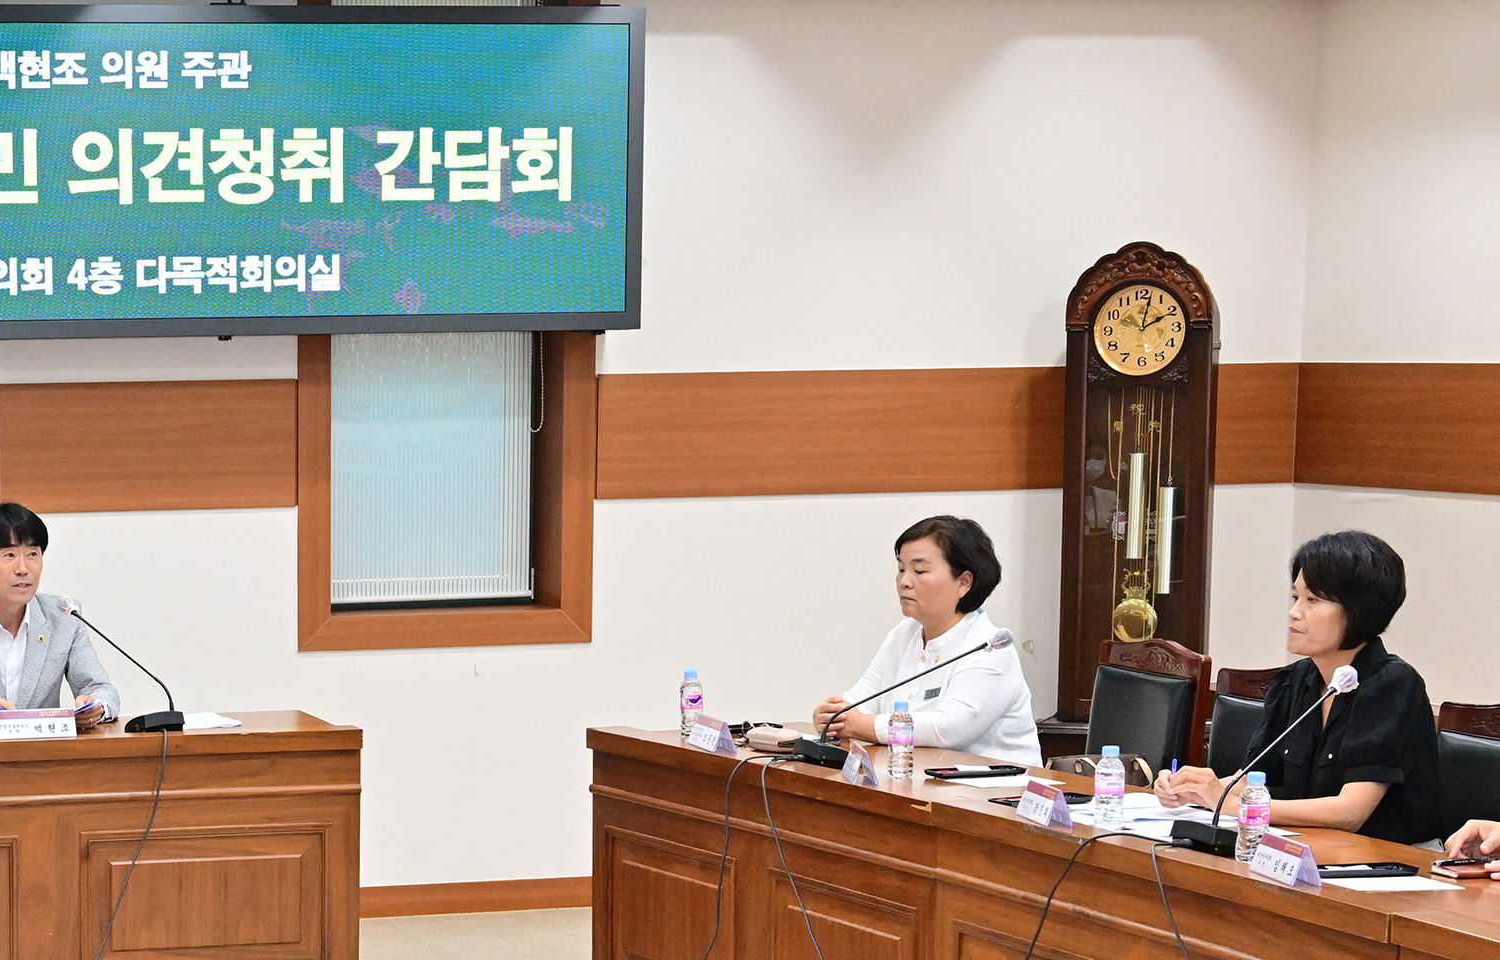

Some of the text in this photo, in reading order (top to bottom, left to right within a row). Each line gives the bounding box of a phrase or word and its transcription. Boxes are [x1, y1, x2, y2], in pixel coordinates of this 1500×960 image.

[100, 50, 169, 89] 의원
[181, 50, 252, 89] 주관
[67, 127, 344, 205] 의견청취
[373, 125, 574, 202] 간담회
[67, 256, 124, 295] 4층
[136, 253, 341, 294] 다목적회의실
[1134, 289, 1150, 301] 12
[1158, 294, 1164, 305] 1
[1119, 296, 1131, 307] 11
[1107, 309, 1120, 321] 10
[1167, 305, 1178, 317] 2
[1103, 326, 1114, 336] 9
[1171, 321, 1182, 333] 3
[1107, 340, 1119, 351] 8
[1165, 337, 1176, 348] 4
[1120, 352, 1131, 363] 7
[1137, 356, 1147, 367] 6
[1154, 351, 1165, 362] 5
